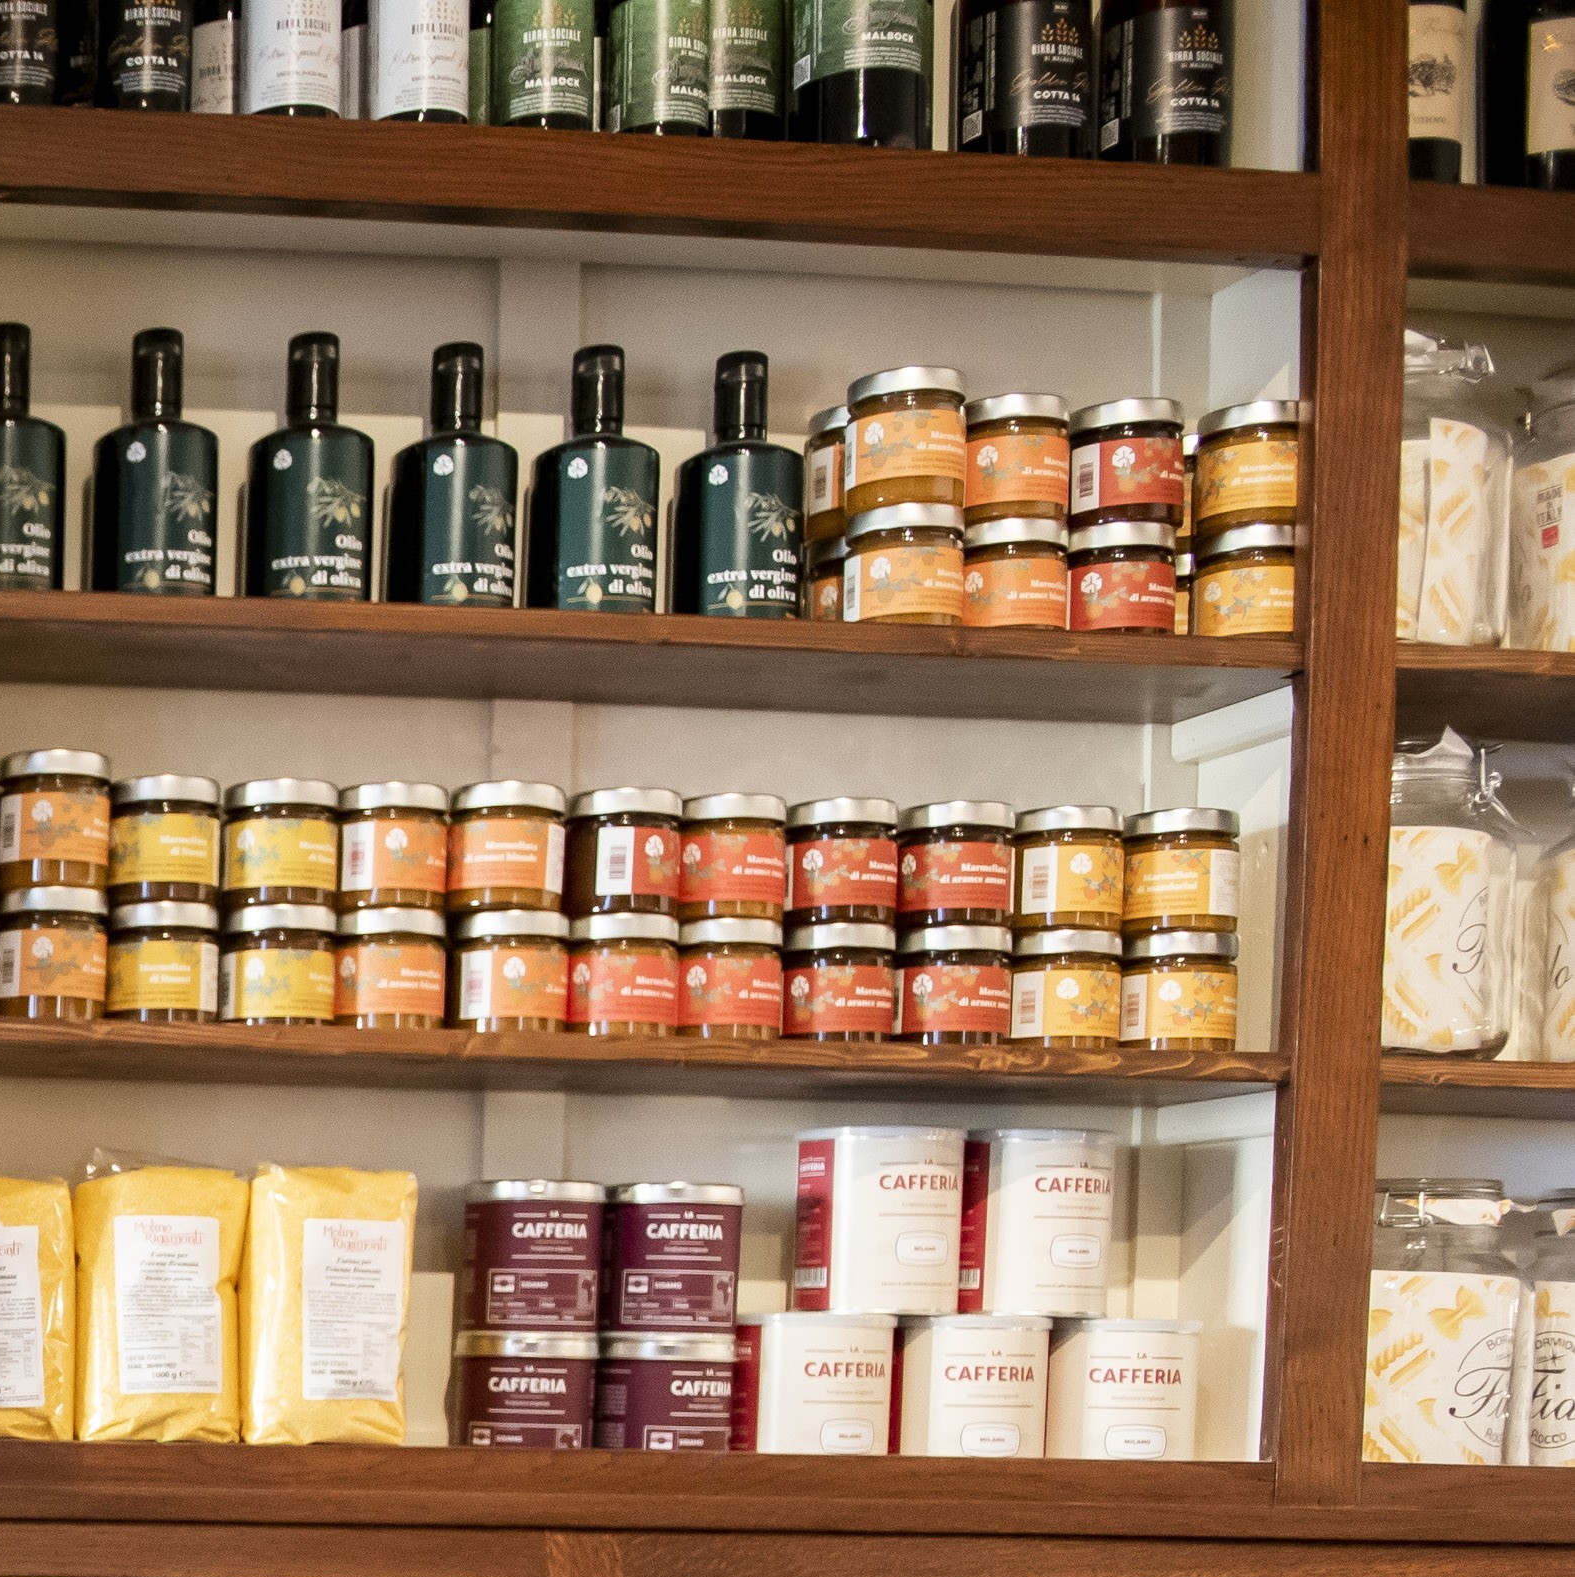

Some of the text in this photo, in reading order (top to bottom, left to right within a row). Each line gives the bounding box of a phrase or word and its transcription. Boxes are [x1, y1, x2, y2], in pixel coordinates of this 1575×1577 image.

[523, 28, 581, 42] BIRRA SOCIALE
[860, 31, 914, 43] MALBOCK
[524, 77, 580, 89] MALBOCK
[1033, 90, 1070, 100] COTTA
[773, 549, 797, 565] Olio
[707, 568, 796, 585] extra vergine
[749, 585, 797, 601] di oliva
[961, 863, 1006, 874] Marmellata
[940, 874, 1006, 885] di arance amare
[879, 1174, 959, 1191] CAFFERIA
[512, 1222, 587, 1239] CAFFERIA
[647, 1223, 723, 1240] CAFFERIA
[804, 1362, 886, 1378] CAFFERIA
[945, 1365, 1034, 1382] CAFFERIA
[1089, 1368, 1182, 1385] CAFFERIA
[488, 1377, 566, 1394] CAFFERIA
